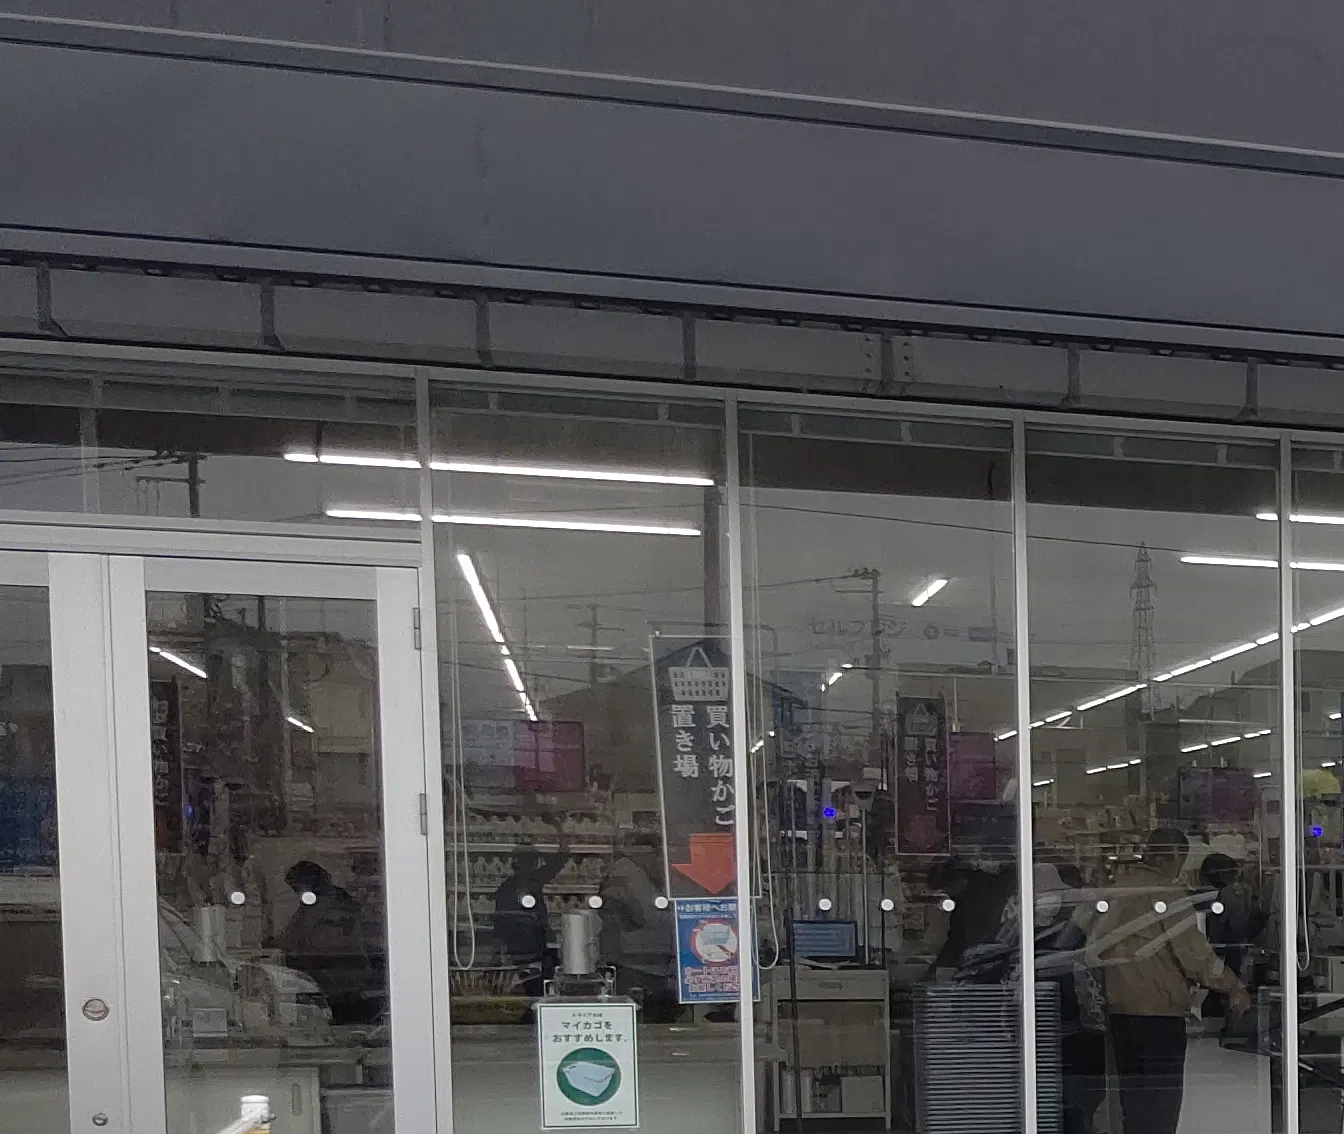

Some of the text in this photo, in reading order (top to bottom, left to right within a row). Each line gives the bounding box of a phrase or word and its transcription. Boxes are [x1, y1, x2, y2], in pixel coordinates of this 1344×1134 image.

[670, 704, 700, 778] 置き場
[706, 705, 736, 826] 買い物かご
[552, 1034, 628, 1043] おすすめします。
[561, 1021, 613, 1030] マイカゴを
